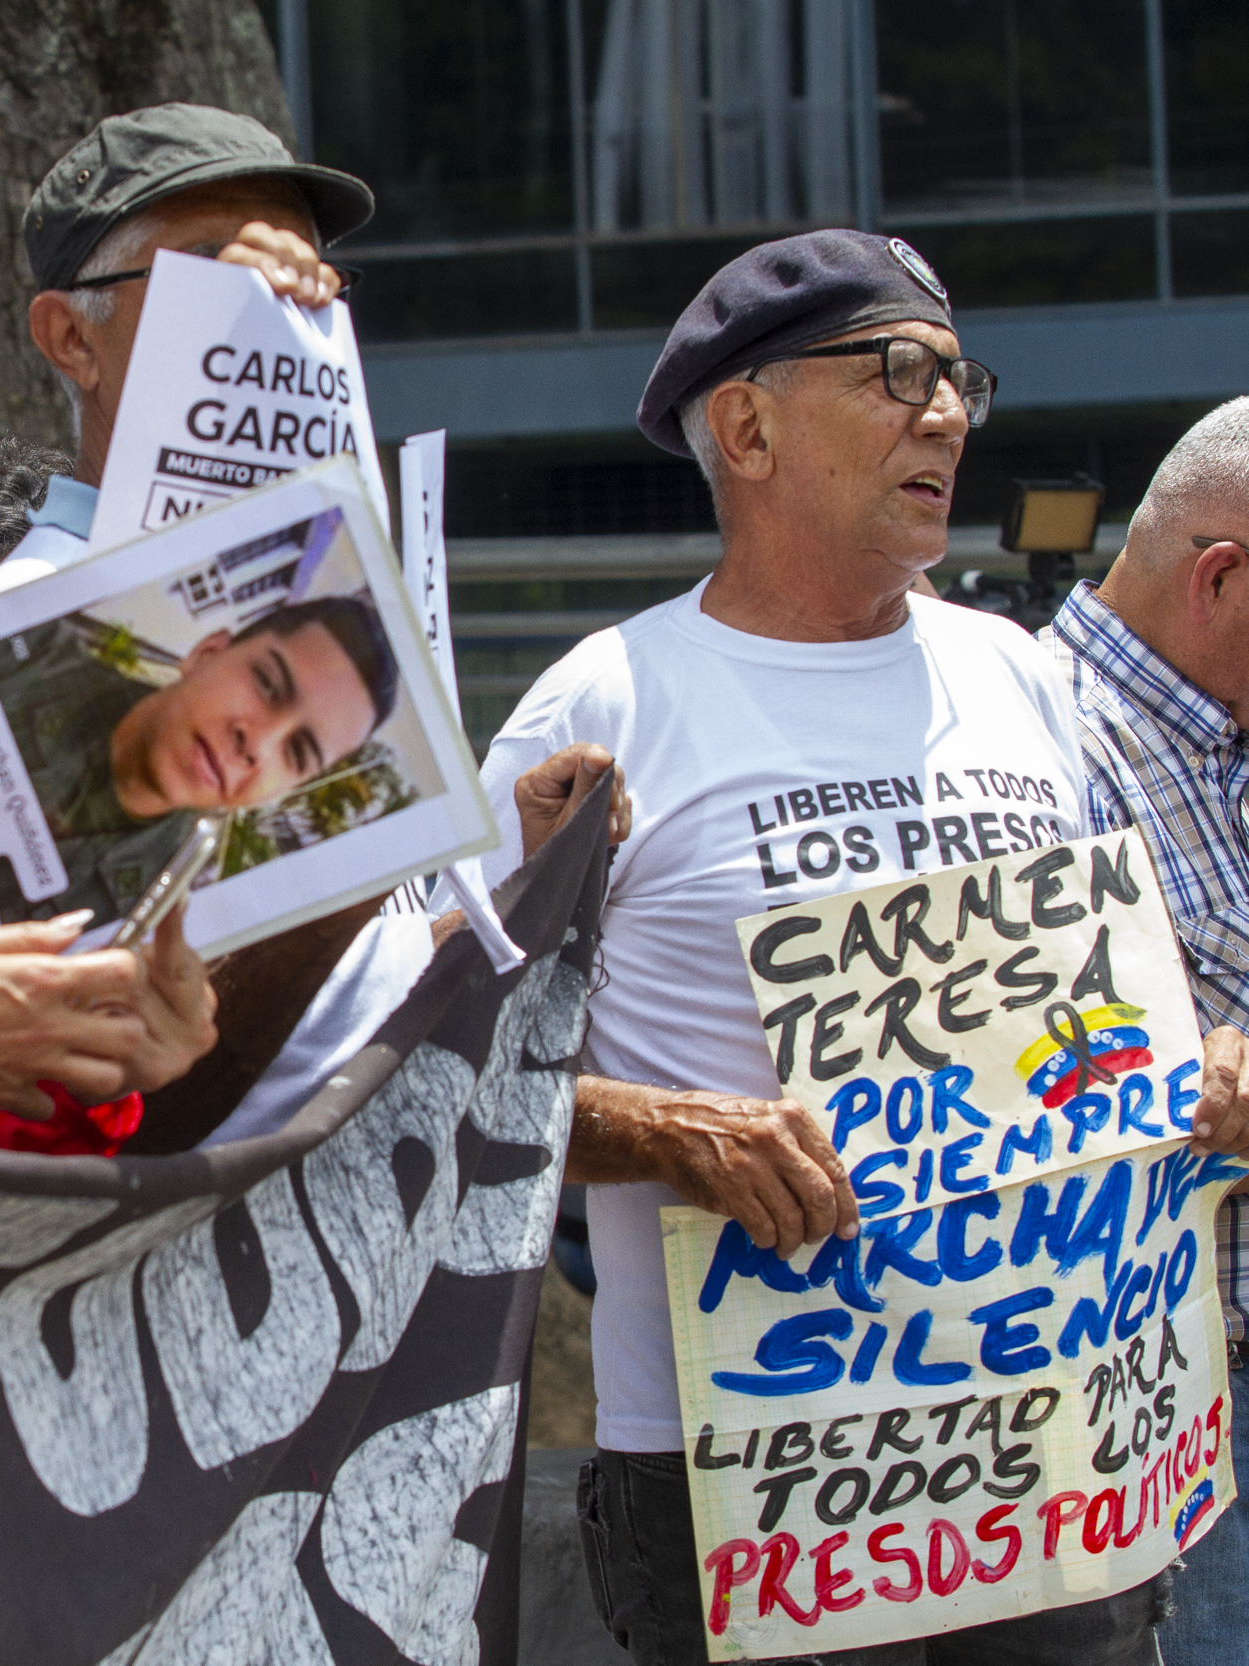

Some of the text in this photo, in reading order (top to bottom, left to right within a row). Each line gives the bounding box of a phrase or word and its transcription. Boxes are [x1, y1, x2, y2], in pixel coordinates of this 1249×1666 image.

[187, 398, 360, 460] GARCÍA
[202, 344, 351, 405] CARLOS
[166, 452, 298, 485] MUERTO BA
[747, 768, 1059, 836] LIBEREN A TODOS
[756, 825, 880, 889] LOS
[750, 837, 1142, 984] CARMEN
[762, 923, 1147, 1086] TERESA
[824, 1064, 992, 1155] POR
[848, 1058, 1202, 1219] SIEMPRE
[699, 1142, 1249, 1313] MARCHA DEL
[711, 1228, 1199, 1397] SILENCIO
[694, 1312, 1188, 1471] LIBERTAD PARA
[753, 1383, 1176, 1533] TODOS LOS
[704, 1503, 1023, 1636] PRESOS
